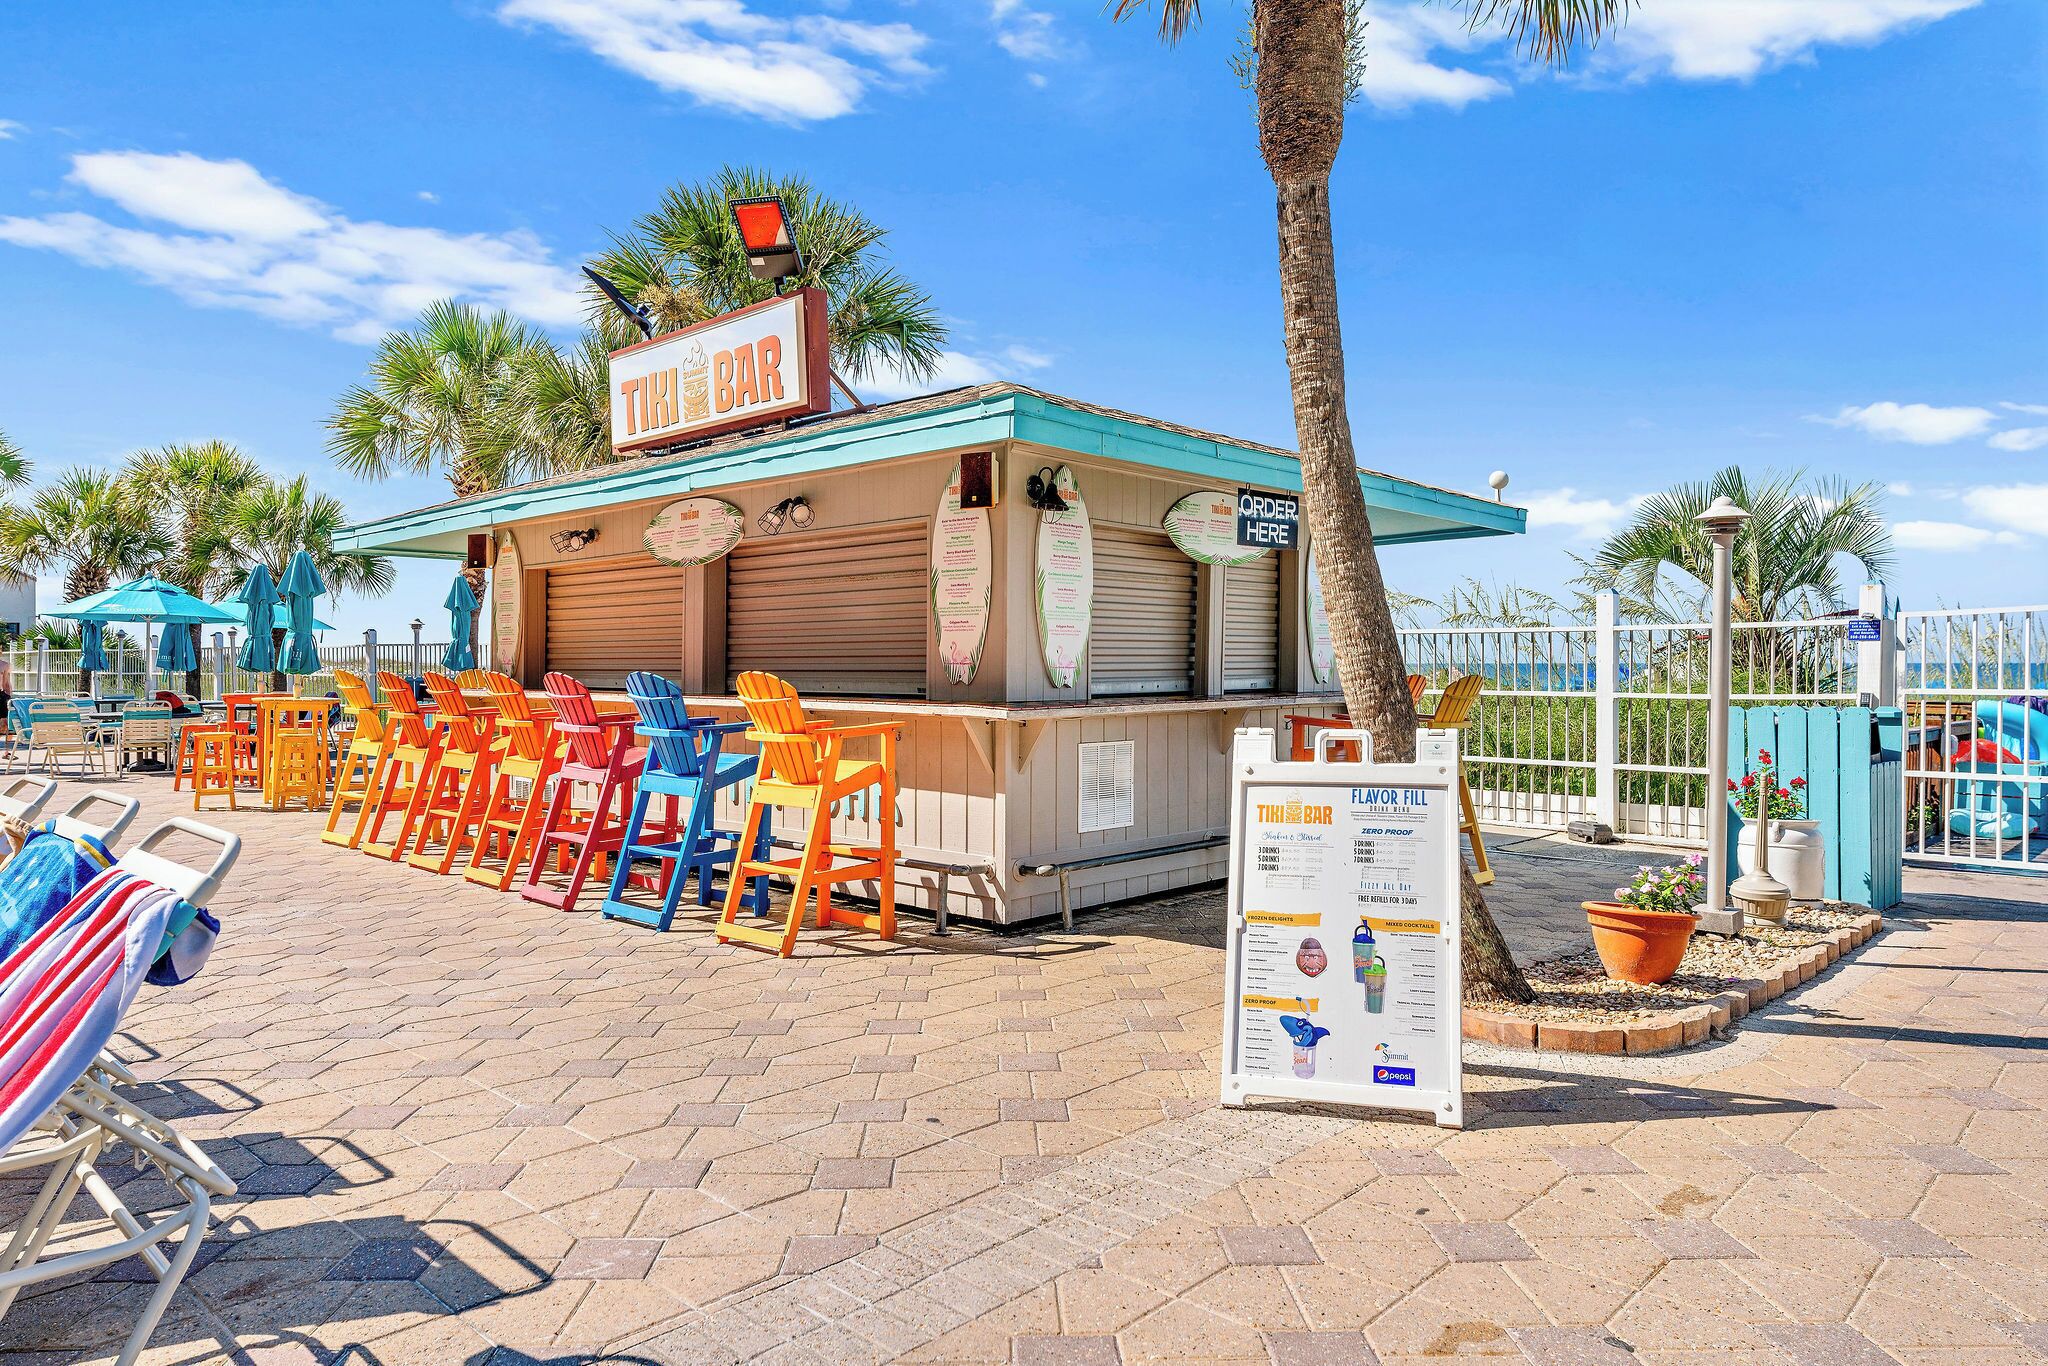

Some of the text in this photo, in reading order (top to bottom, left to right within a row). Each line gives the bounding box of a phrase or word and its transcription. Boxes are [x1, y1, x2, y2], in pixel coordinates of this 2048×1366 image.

[683, 366, 708, 380] SUMMIT
[621, 334, 784, 435] TIKI BAR
[1240, 494, 1297, 520] ORDER
[1246, 520, 1289, 544] HERE
[1352, 789, 1428, 806] FLAVOR FILL
[1257, 804, 1333, 825] TIKI BAR
[1381, 1049, 1408, 1063] Summit
[1389, 1071, 1412, 1081] pepsi
